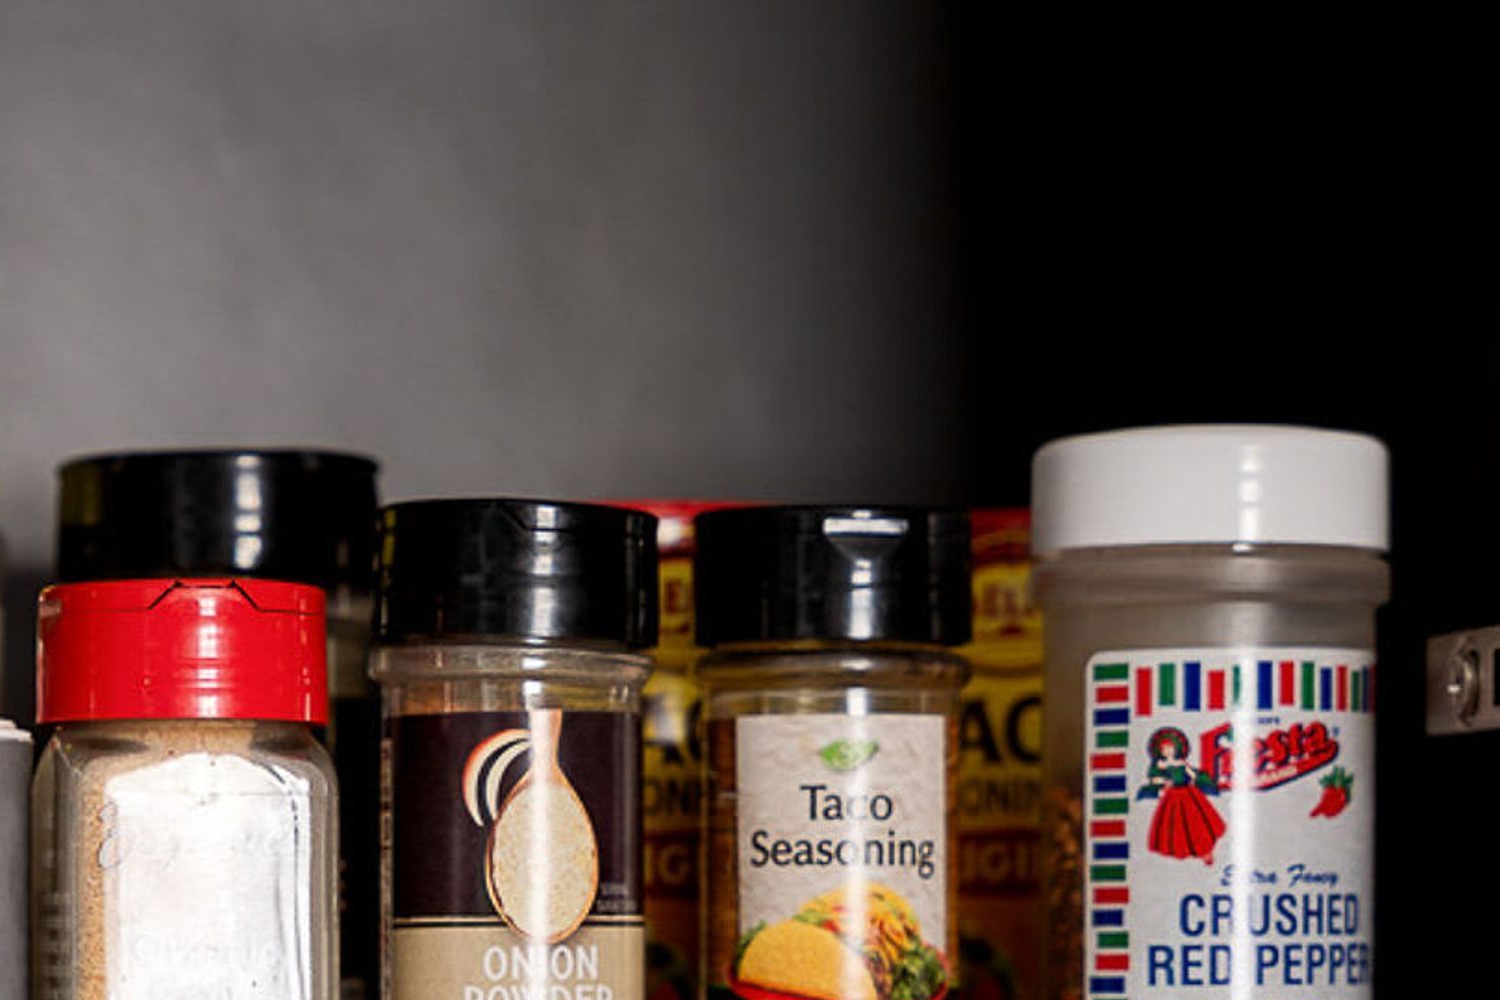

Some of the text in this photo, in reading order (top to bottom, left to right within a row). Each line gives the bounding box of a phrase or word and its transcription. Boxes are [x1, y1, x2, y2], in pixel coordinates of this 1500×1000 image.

[800, 784, 893, 822] Taco
[750, 829, 934, 880] Seasoning
[1179, 893, 1359, 937] CRUSHED
[482, 944, 599, 981] ONON
[1148, 942, 1370, 986] RED PEPPER
